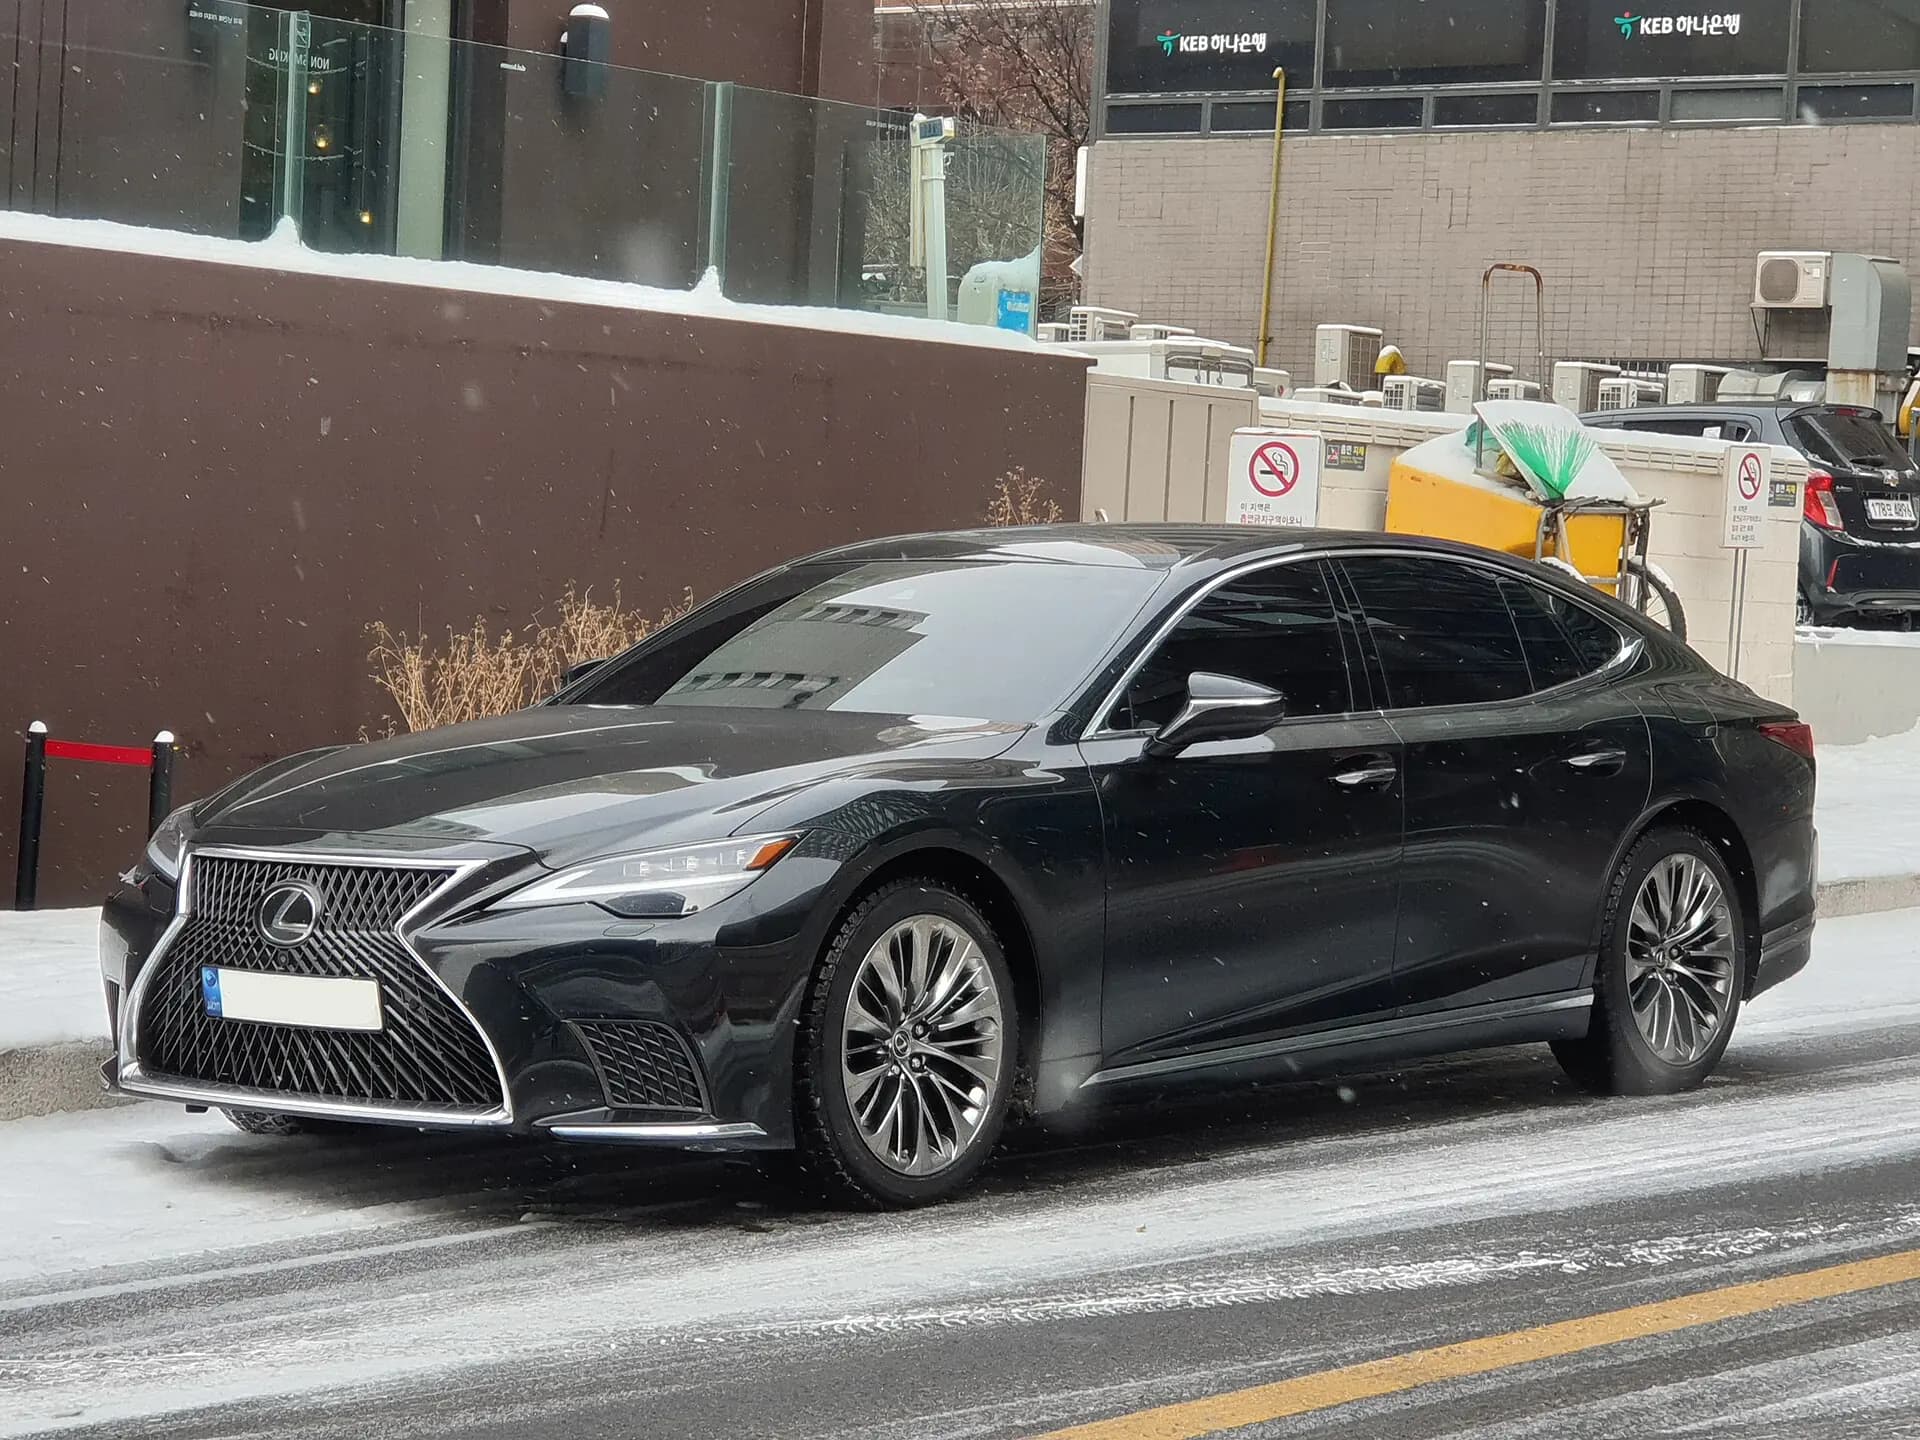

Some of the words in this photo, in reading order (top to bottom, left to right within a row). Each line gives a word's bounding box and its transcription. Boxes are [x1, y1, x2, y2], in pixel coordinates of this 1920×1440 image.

[1640, 17, 1673, 35] KEB
[1676, 14, 1741, 36] 하나은행
[1179, 35, 1209, 52] KEB
[1211, 32, 1267, 53] 하나은행
[1240, 502, 1248, 511] 이
[1250, 502, 1271, 512] 지역은
